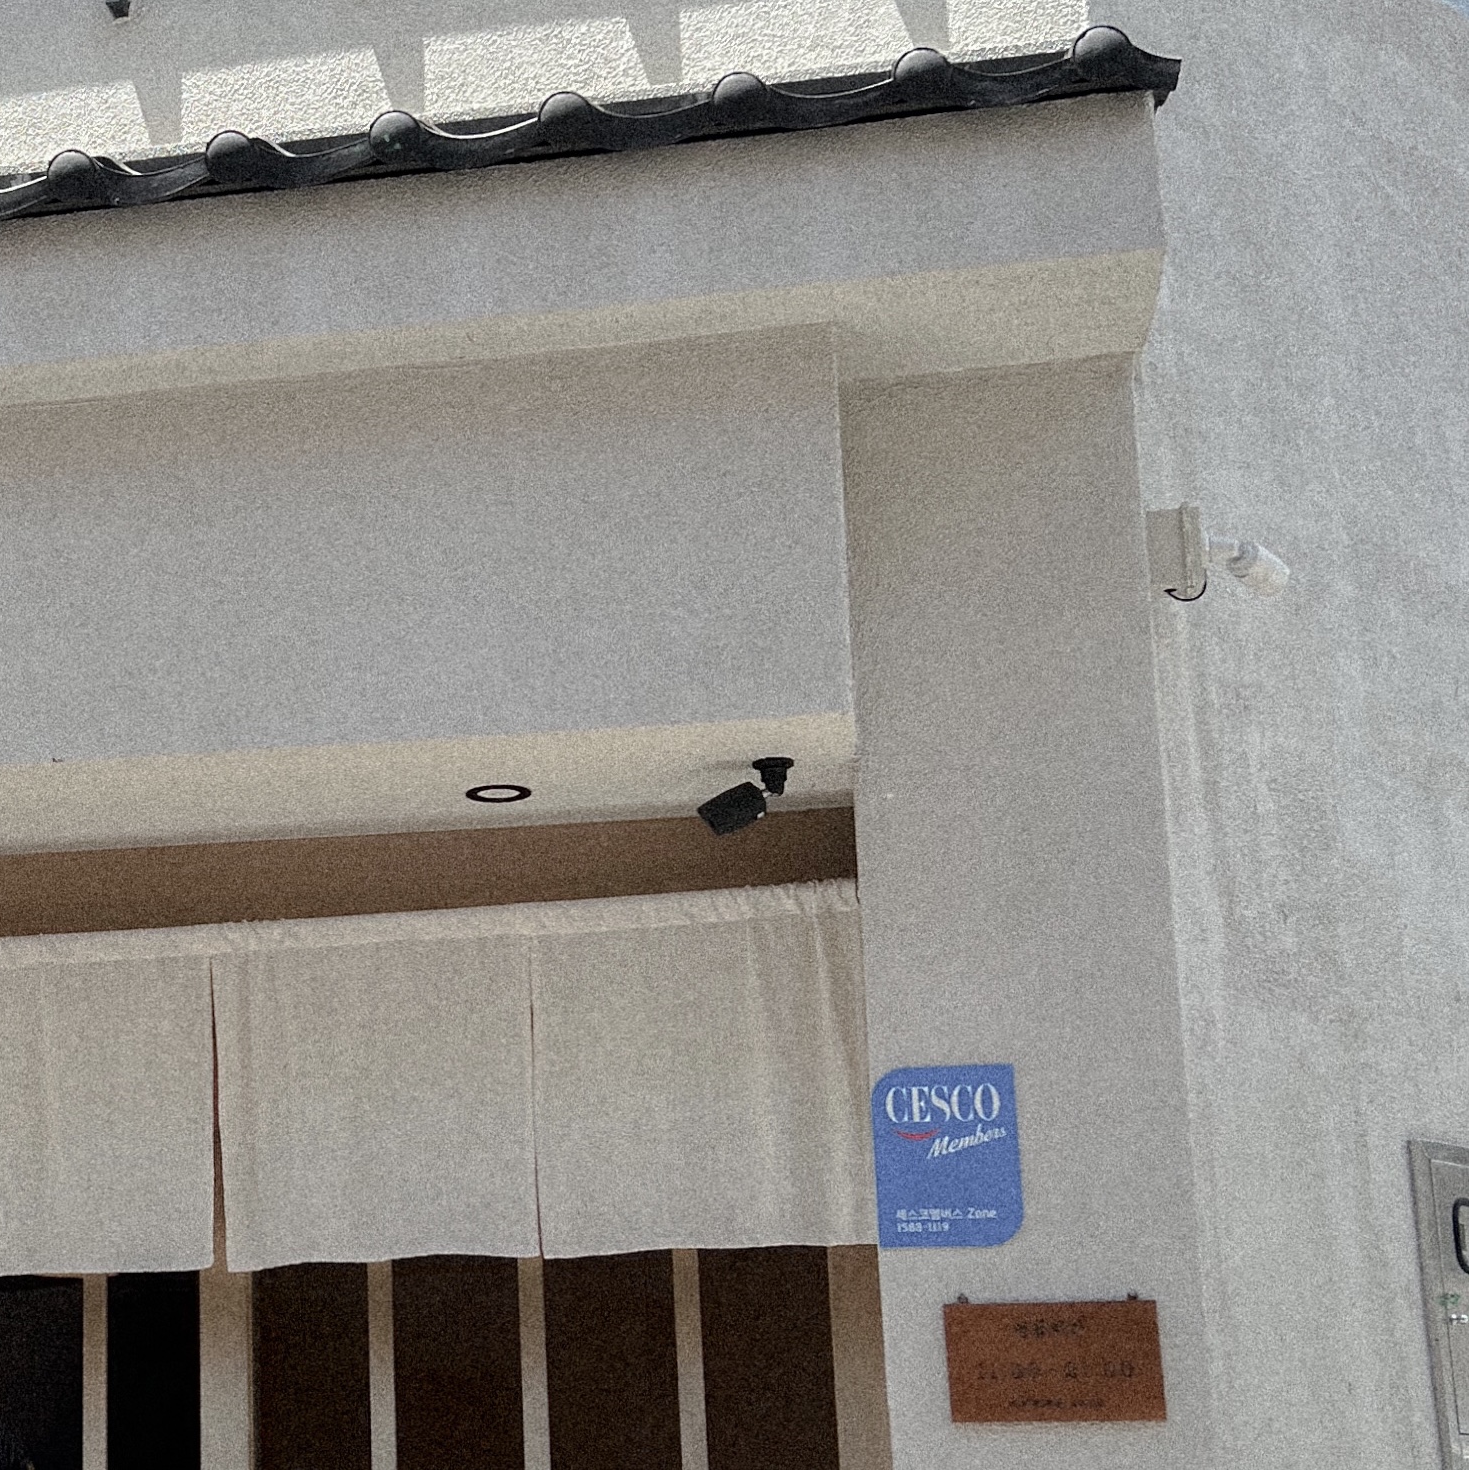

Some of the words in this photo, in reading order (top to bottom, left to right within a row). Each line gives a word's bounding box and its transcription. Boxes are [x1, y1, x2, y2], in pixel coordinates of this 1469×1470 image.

[885, 1082, 1002, 1124] CESCO
[925, 1123, 1008, 1160] Members
[967, 1207, 998, 1220] Zone
[897, 1221, 950, 1233] 1588-1119
